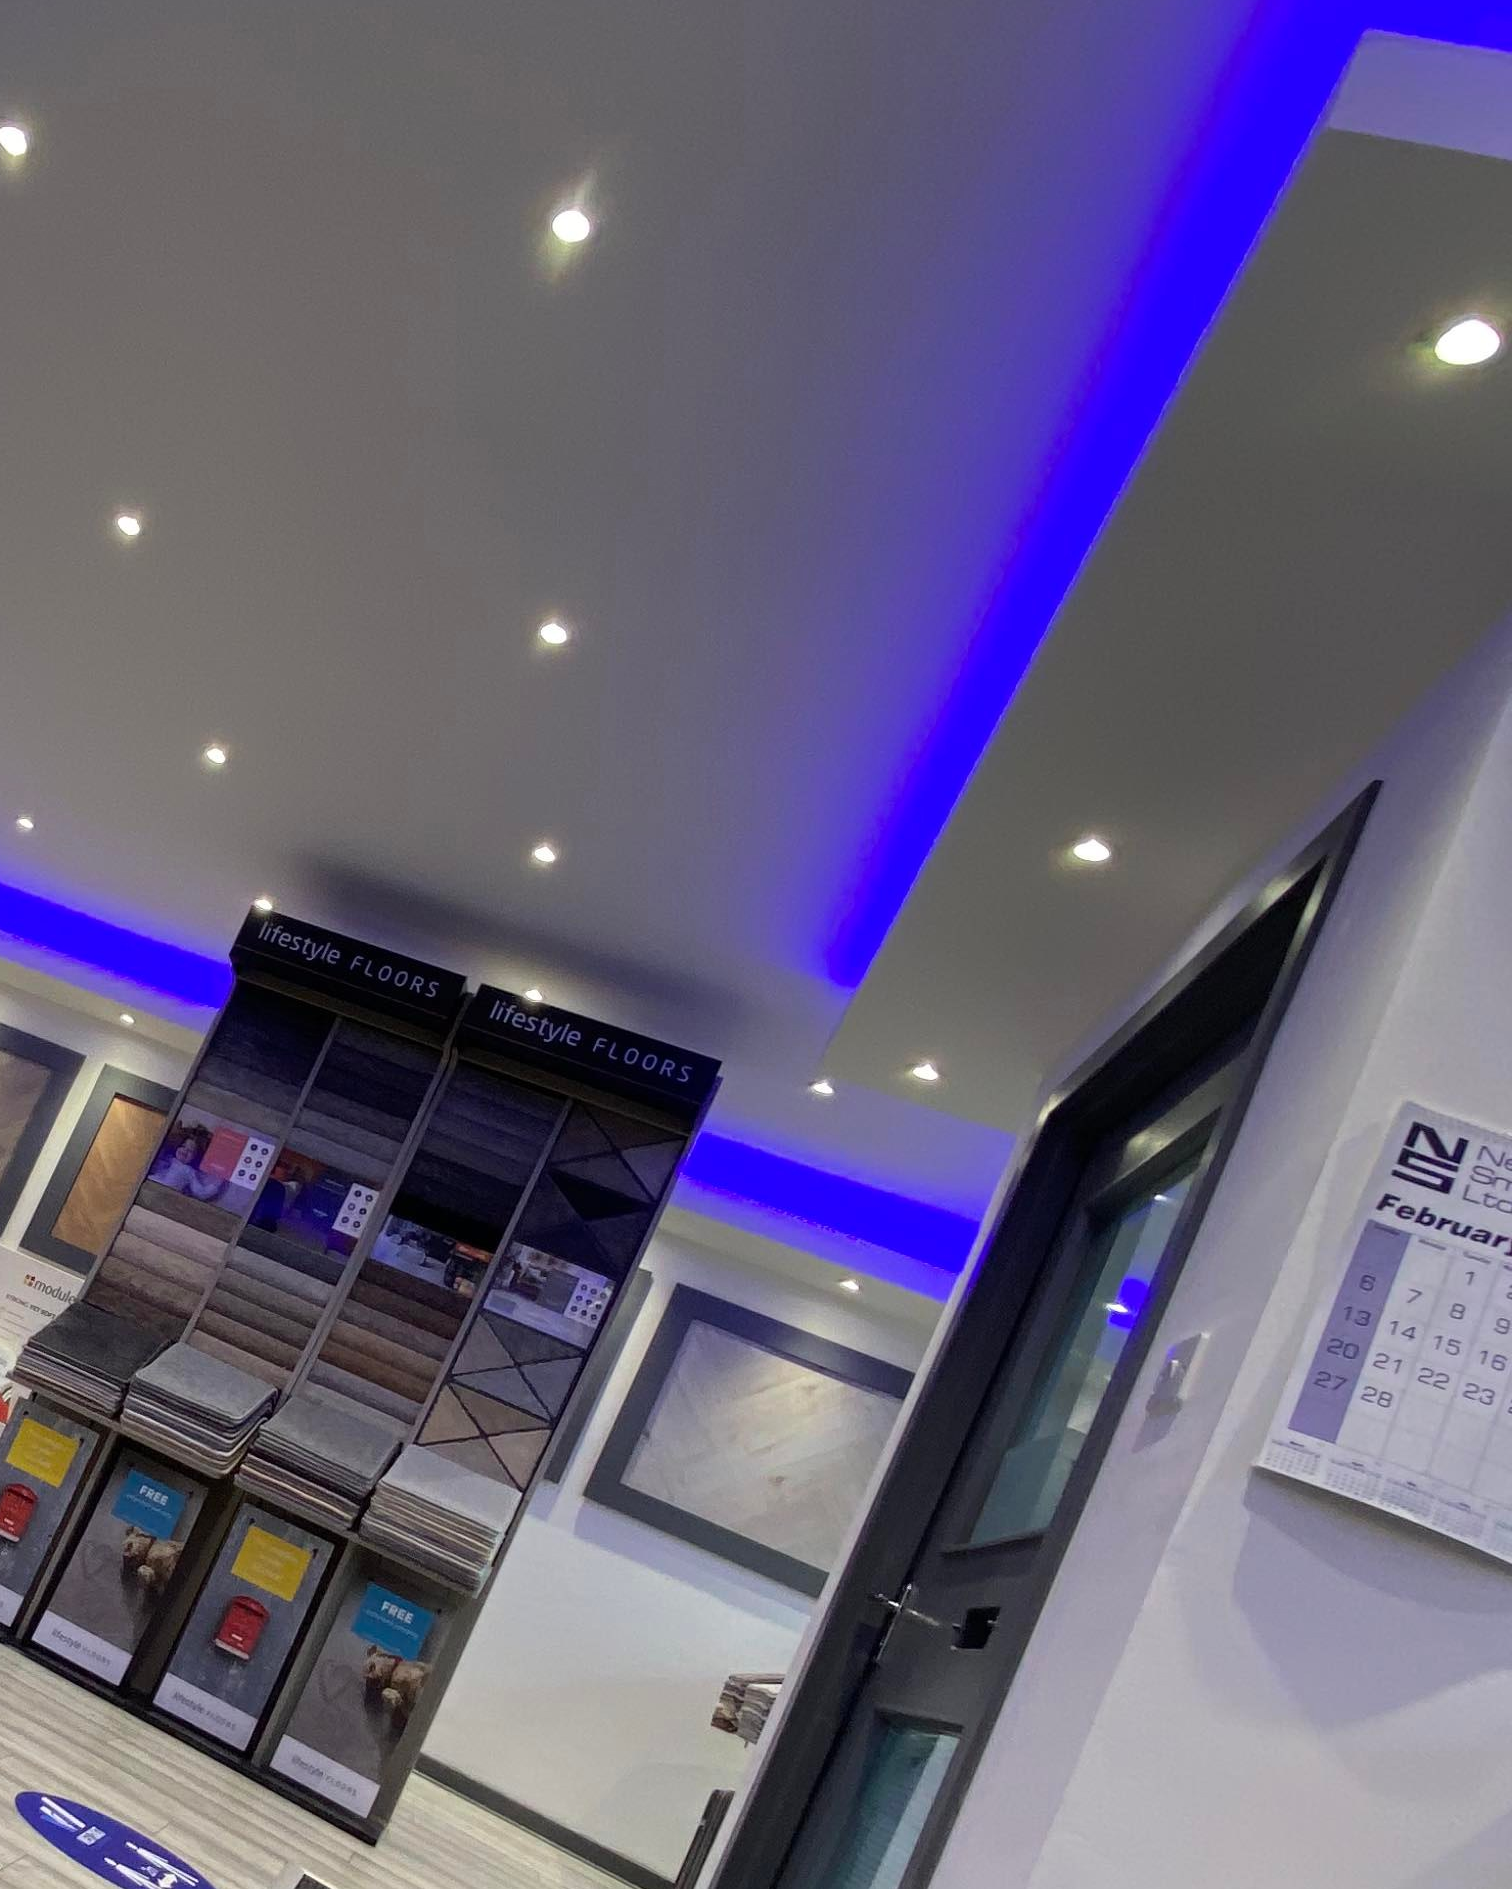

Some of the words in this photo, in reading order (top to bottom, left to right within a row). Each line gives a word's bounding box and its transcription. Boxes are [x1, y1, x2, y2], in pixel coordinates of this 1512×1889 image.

[257, 921, 341, 965] lifestyle
[349, 955, 440, 998] FLOORS
[489, 1000, 582, 1047] lifestyle
[592, 1038, 693, 1083] FLOORS
[1359, 1274, 1376, 1292] 6
[1406, 1288, 1423, 1304] 7
[1449, 1303, 1466, 1320] 8
[1493, 1317, 1511, 1335] 9
[1464, 1271, 1475, 1286] 1
[1343, 1306, 1371, 1327] 13
[1389, 1321, 1417, 1341] 14
[1433, 1335, 1463, 1356] 15
[1480, 1350, 1508, 1371] 16
[1313, 1371, 1348, 1391] 27
[1360, 1386, 1393, 1408] 28
[1326, 1338, 1360, 1360] 20
[1373, 1353, 1403, 1374] 21
[1417, 1367, 1450, 1391] 22
[1462, 1383, 1496, 1406] 23
[139, 1485, 169, 1506] FREE
[381, 1600, 414, 1624] FREE
